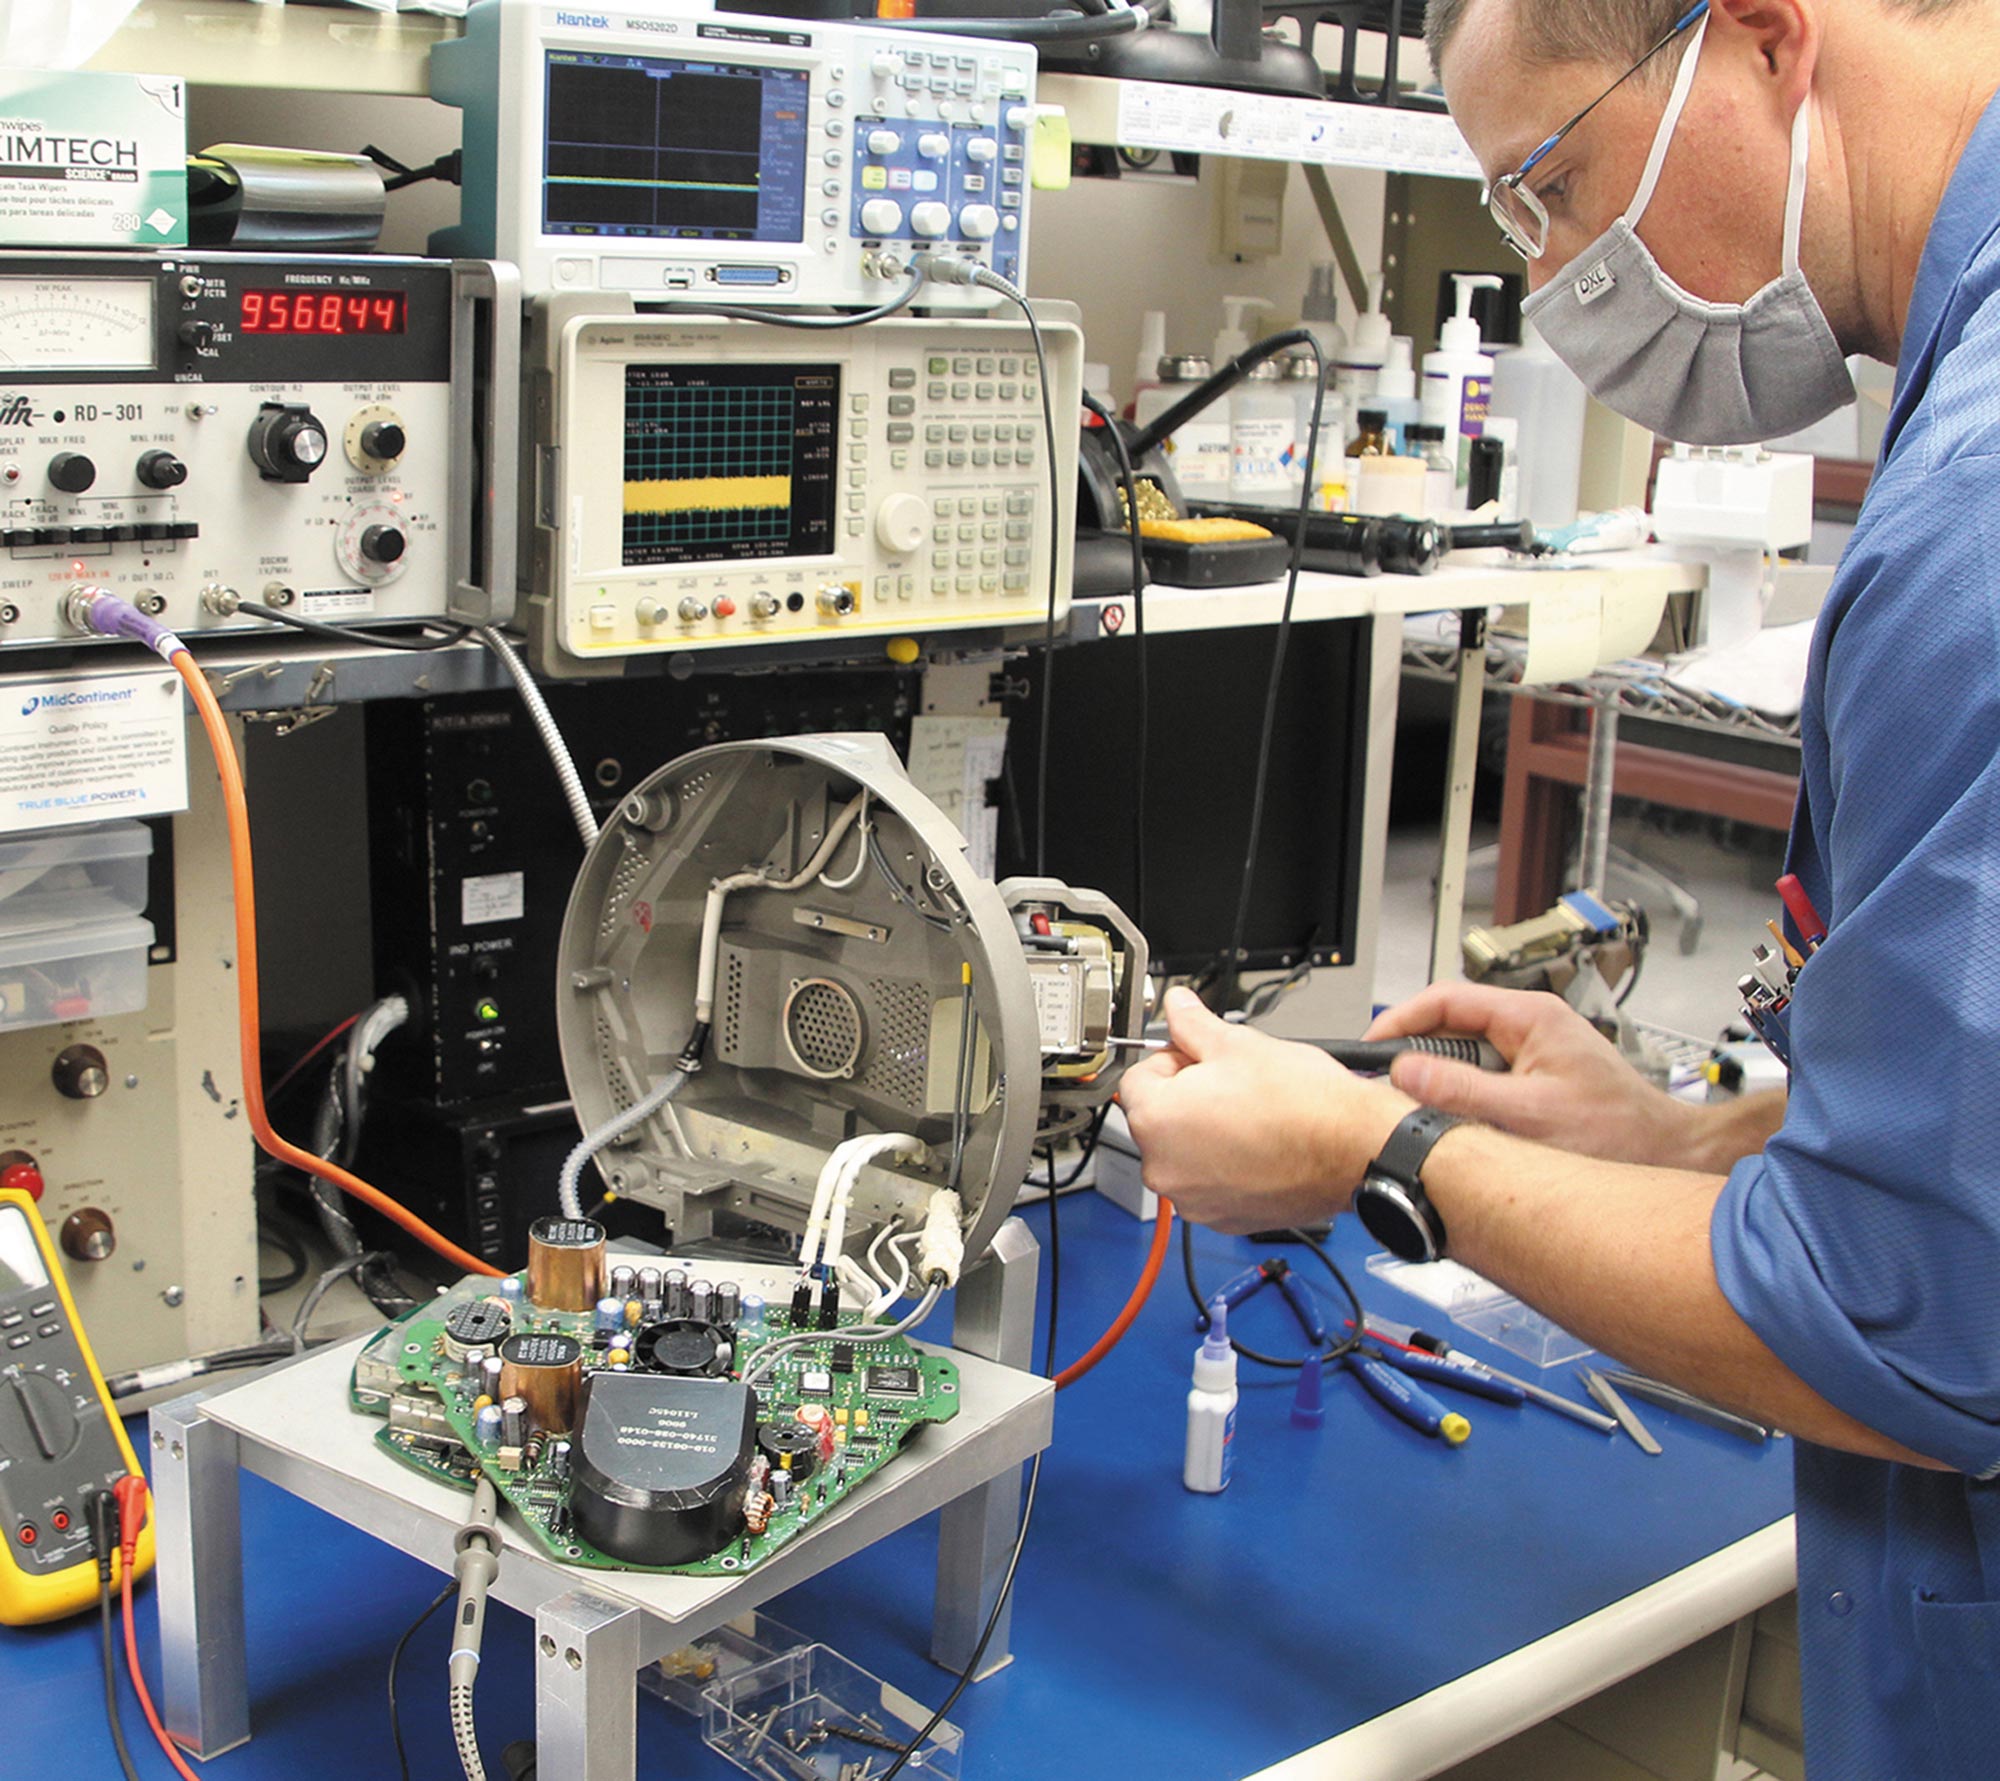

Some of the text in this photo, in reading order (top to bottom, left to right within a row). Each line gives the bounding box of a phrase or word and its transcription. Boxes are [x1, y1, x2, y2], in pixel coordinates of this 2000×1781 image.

[556, 12, 609, 28] Hantek
[172, 84, 180, 107] 1
[112, 214, 140, 231] 280
[285, 274, 332, 285] FREQUENCY
[2, 580, 32, 589] SWEEP
[48, 721, 108, 735] Quality Policy
[18, 789, 137, 811] TRUE BLUE POWER
